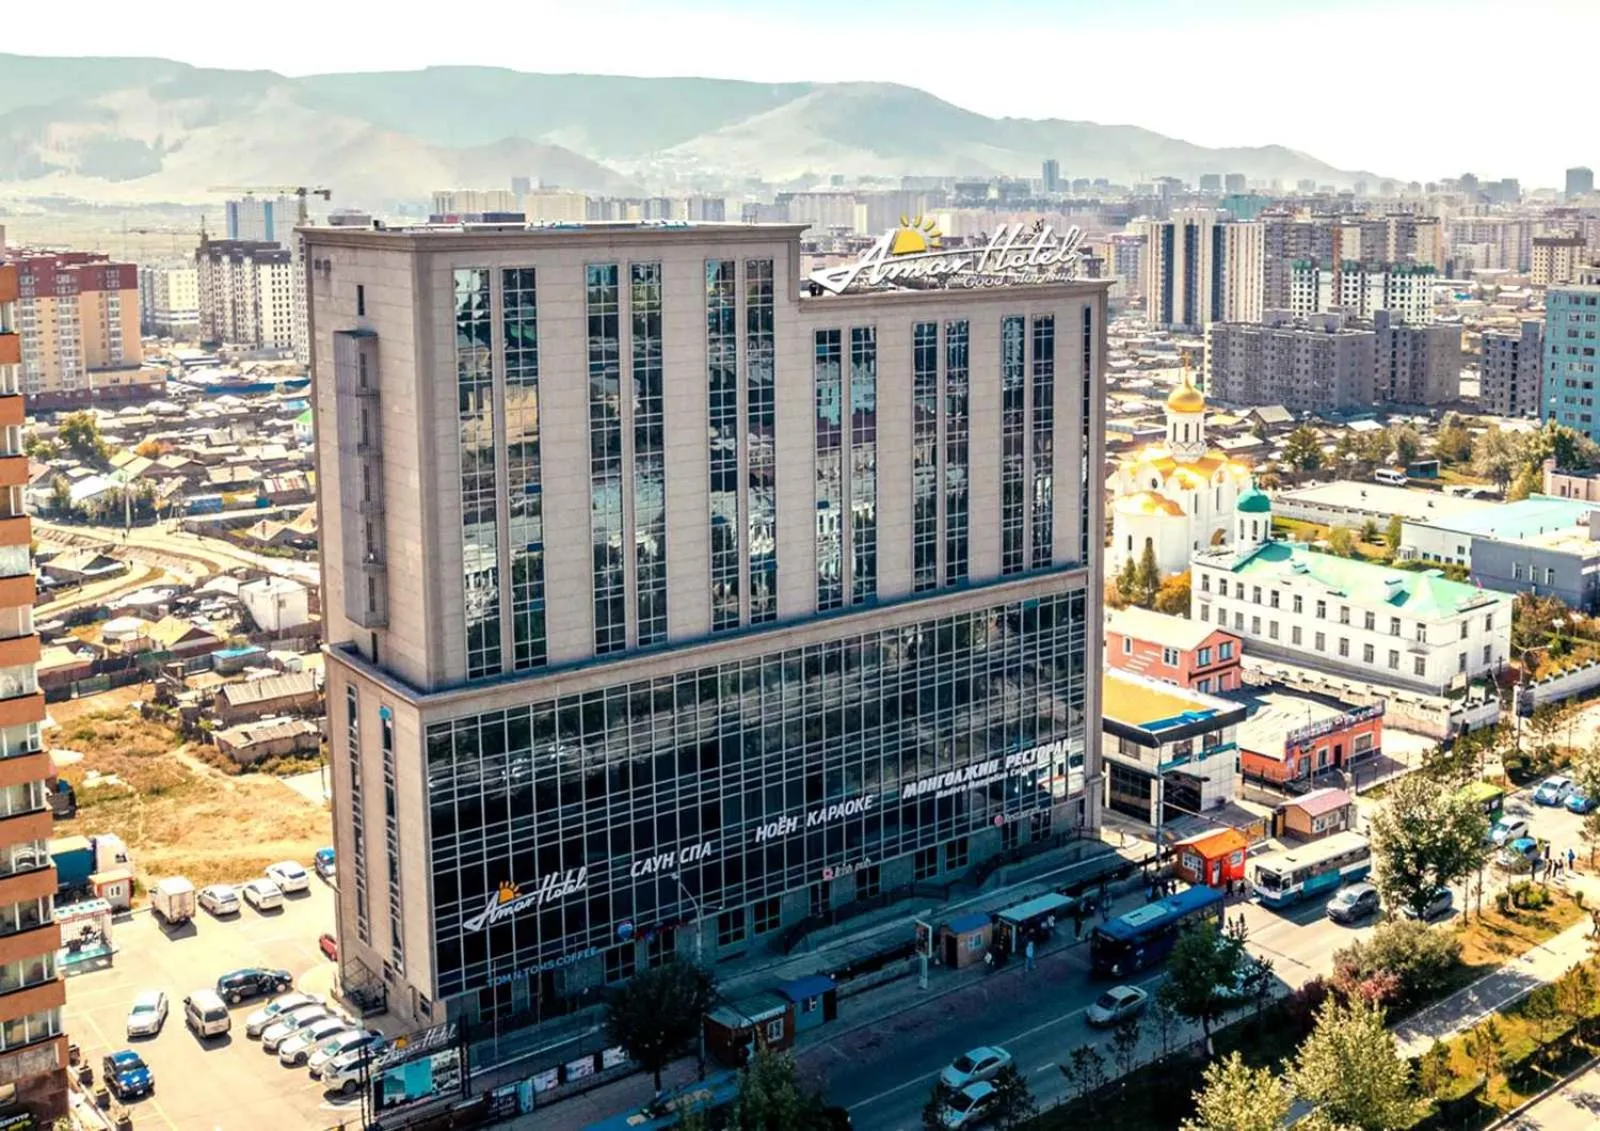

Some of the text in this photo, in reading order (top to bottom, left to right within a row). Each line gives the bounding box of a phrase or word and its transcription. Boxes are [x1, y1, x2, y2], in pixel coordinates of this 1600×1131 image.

[808, 224, 1088, 294] Amar Hotel
[902, 739, 1072, 799] МОНГОЛЖИН РЕСТОРАН
[755, 795, 872, 843] НОЁН КАРАОКЕ
[630, 842, 712, 878] САУН СПА
[463, 867, 588, 932] Amar Hotel
[556, 946, 598, 967] COFFEE
